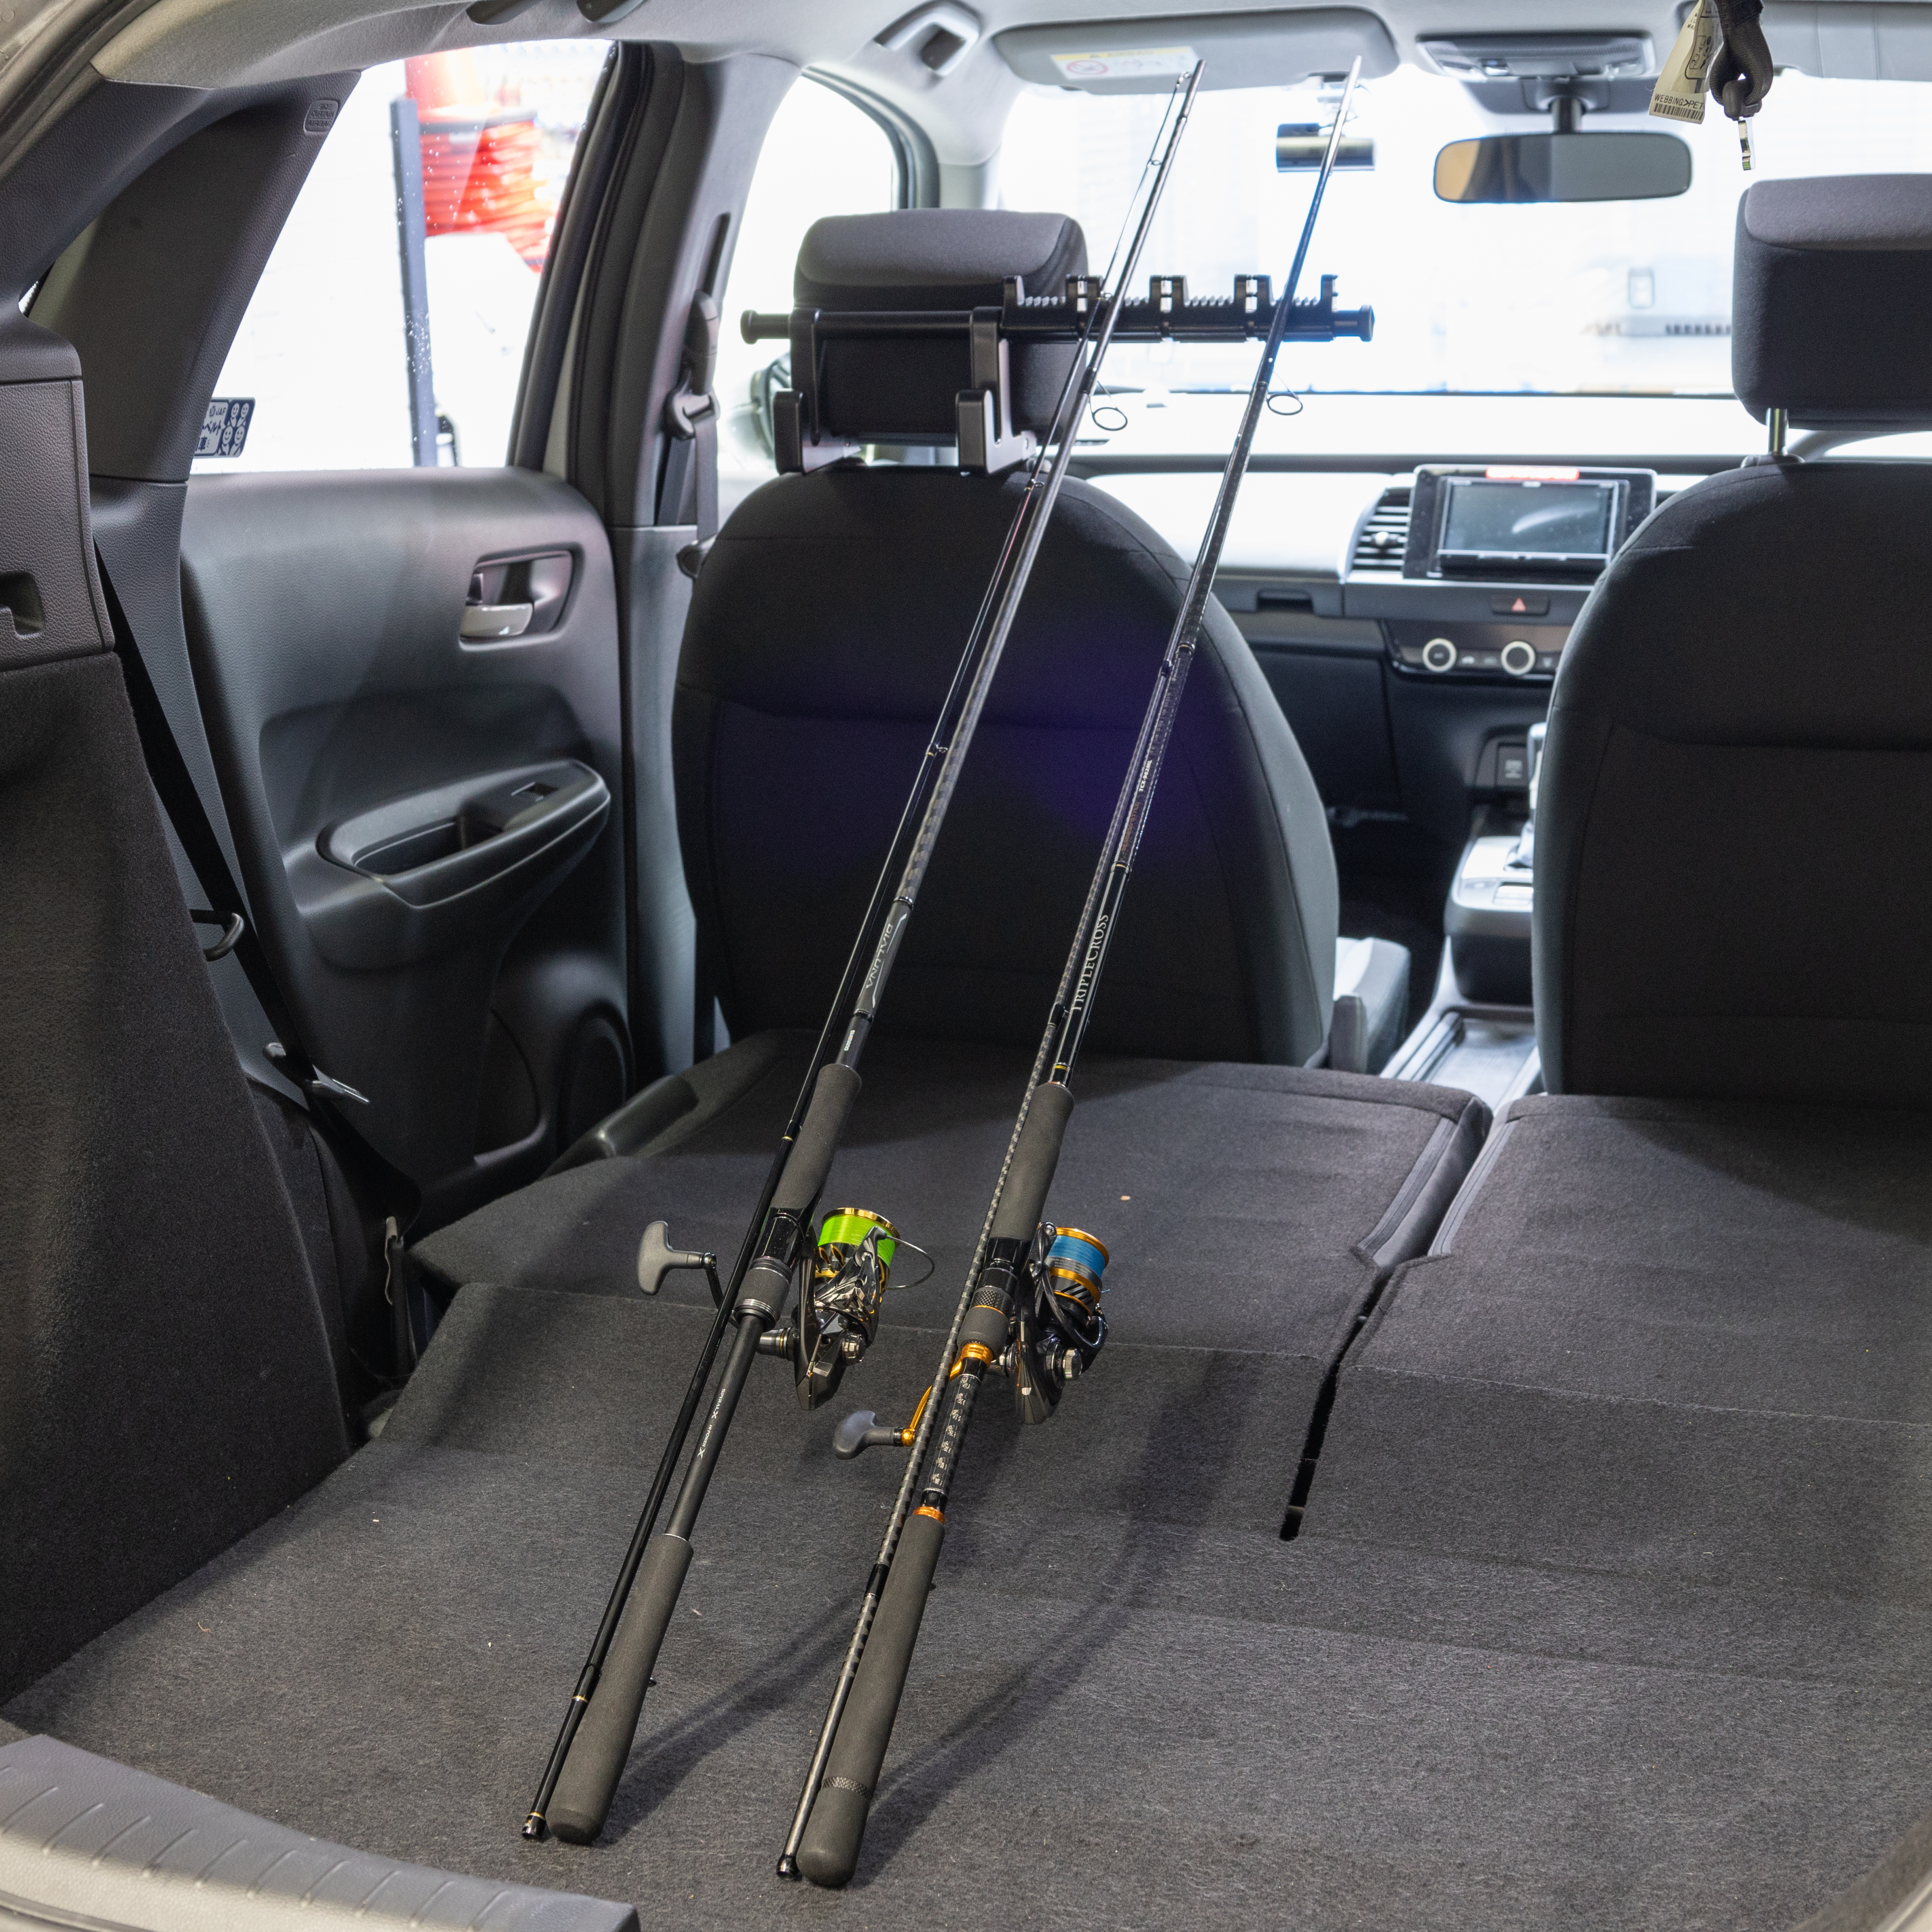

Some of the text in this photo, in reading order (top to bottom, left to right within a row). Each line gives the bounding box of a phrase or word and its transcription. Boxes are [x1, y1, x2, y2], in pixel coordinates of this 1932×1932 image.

[216, 407, 226, 416] JAF
[1139, 759, 1152, 792] TCX-962ML
[865, 924, 893, 989] DIALUNA
[1071, 914, 1108, 1011] TRIPLECROSS
